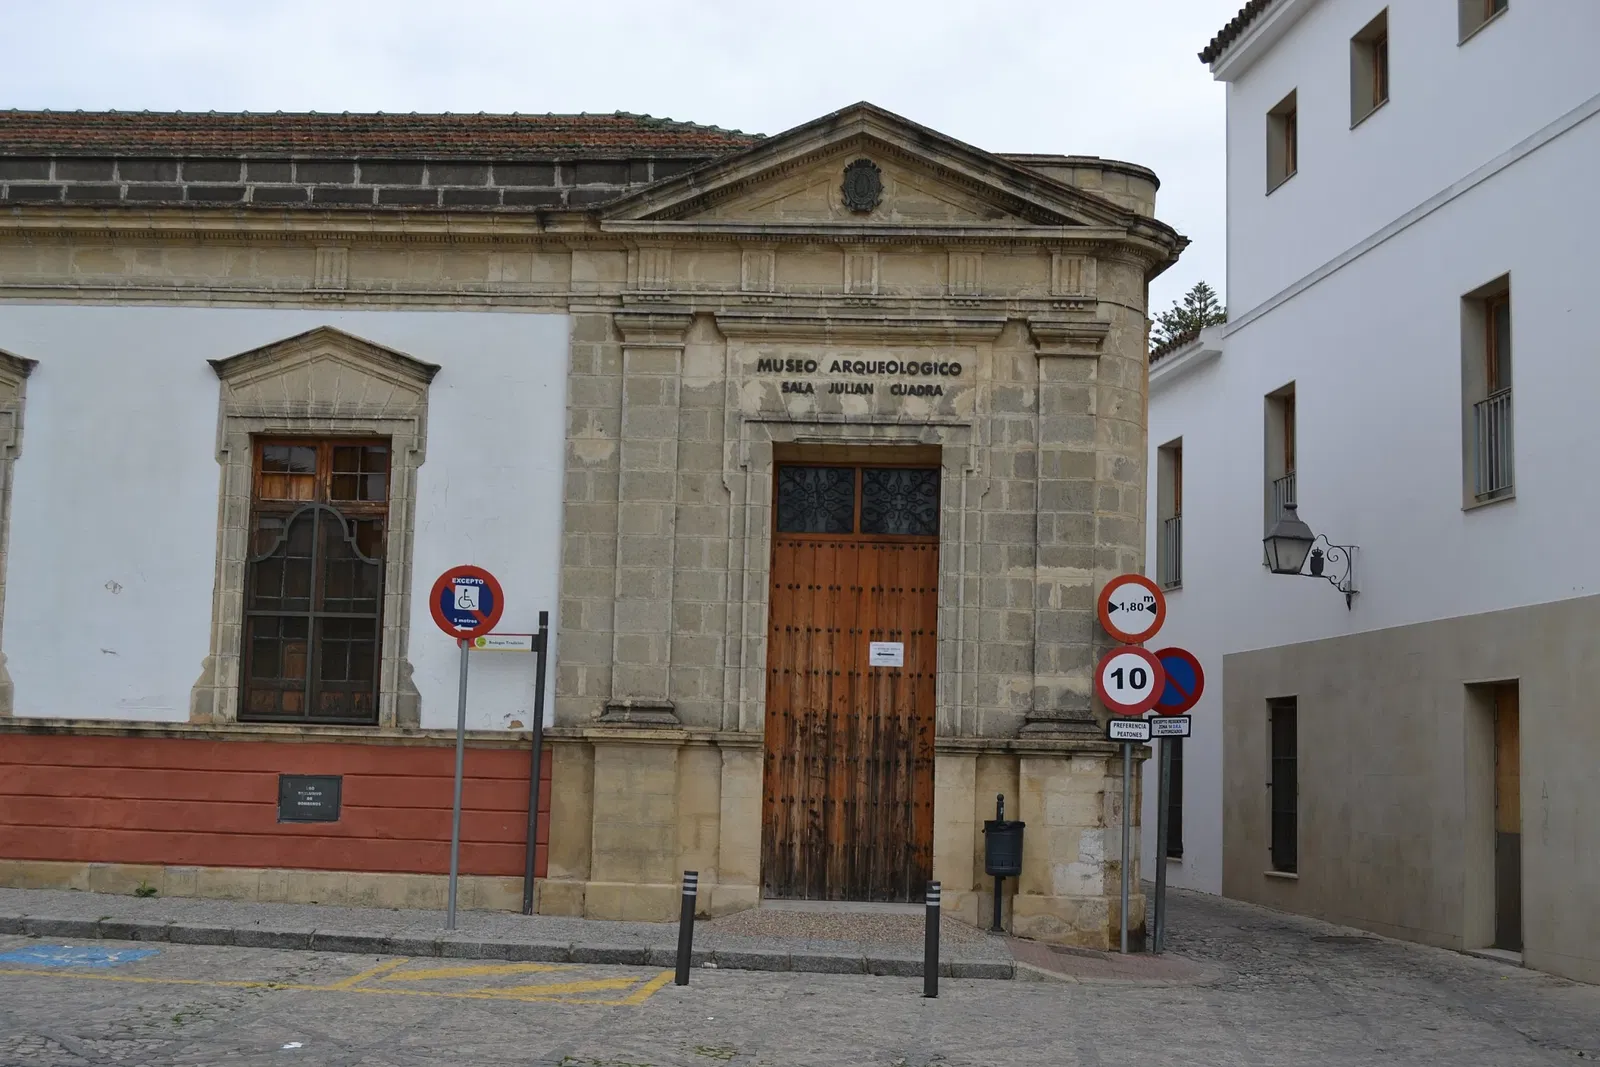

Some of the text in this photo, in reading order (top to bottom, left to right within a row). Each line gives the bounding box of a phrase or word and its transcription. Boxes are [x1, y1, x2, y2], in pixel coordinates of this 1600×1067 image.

[757, 359, 962, 376] MUSEO ARQUEOLOGICO
[782, 381, 943, 396] SALA JULIAN CUADRA
[452, 577, 484, 585] EXCEPTO
[1119, 602, 1144, 612] 1,80
[1110, 667, 1147, 690] 10
